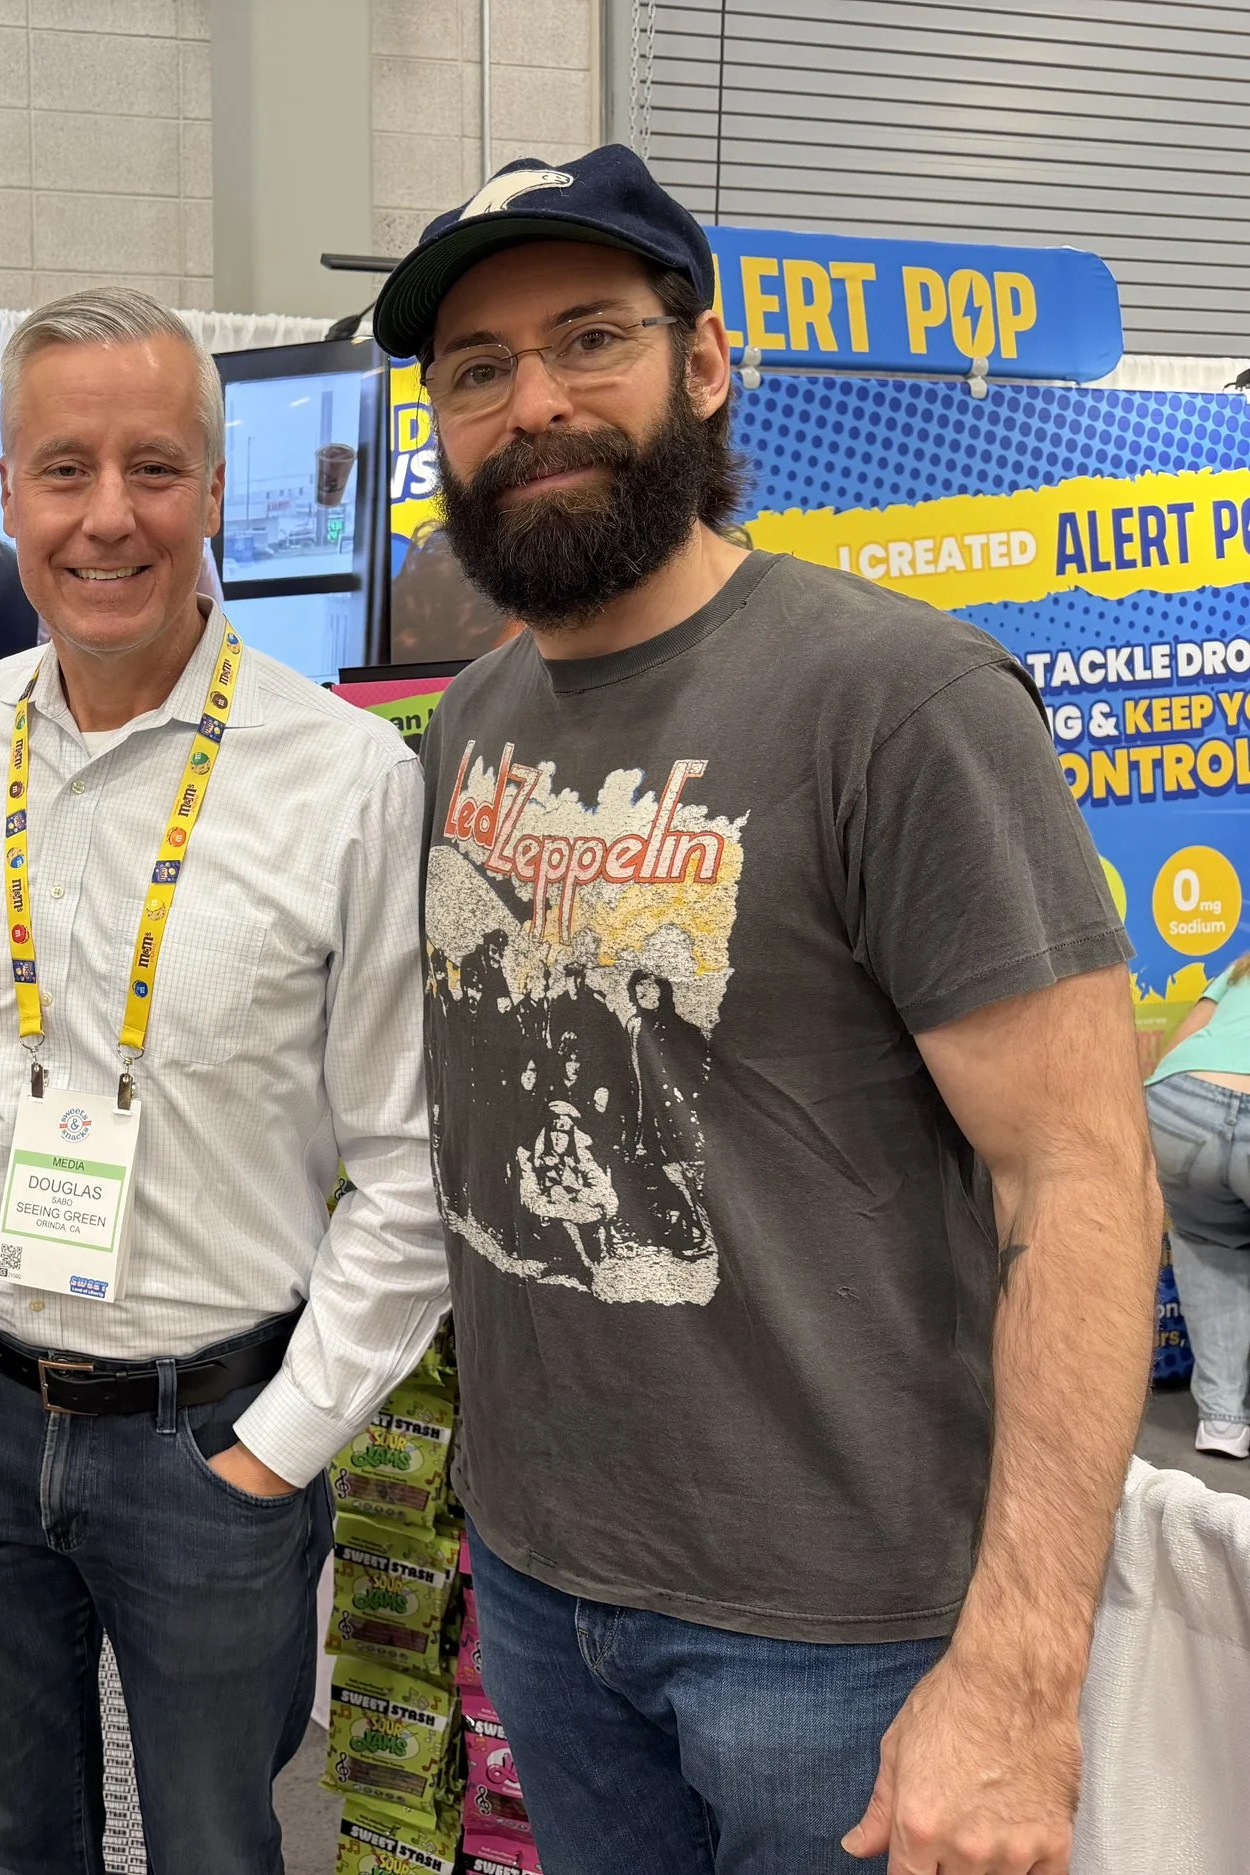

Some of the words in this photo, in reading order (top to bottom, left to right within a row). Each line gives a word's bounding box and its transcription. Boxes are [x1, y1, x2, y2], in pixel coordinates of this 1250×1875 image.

[902, 265, 1037, 360] POP
[858, 529, 1037, 580] CREATED
[1056, 502, 1195, 576] ALERT
[1026, 644, 1172, 688] TACKLE
[1177, 638, 1250, 678] DRO
[1089, 702, 1119, 738] &
[1124, 695, 1214, 735] KEEP
[443, 739, 515, 849] Led
[484, 760, 724, 946] Zeppelin
[1174, 868, 1200, 912] 0
[1200, 900, 1222, 915] mg
[1169, 918, 1226, 935] Sodium
[52, 1157, 85, 1171] MEDIA
[28, 1175, 103, 1200] DOUGLAS
[52, 1196, 73, 1207] SABO
[16, 1202, 60, 1219] SEEING
[63, 1210, 107, 1227] GREEN
[69, 1224, 81, 1234] CA
[374, 1430, 407, 1449] SOUR
[395, 1417, 441, 1440] STASH
[343, 1548, 388, 1571] SWEET
[391, 1562, 435, 1584] STASH
[341, 1690, 387, 1712] SWEET
[391, 1704, 436, 1727] STASH
[350, 1825, 396, 1851] SWEET
[400, 1845, 443, 1872] STASH
